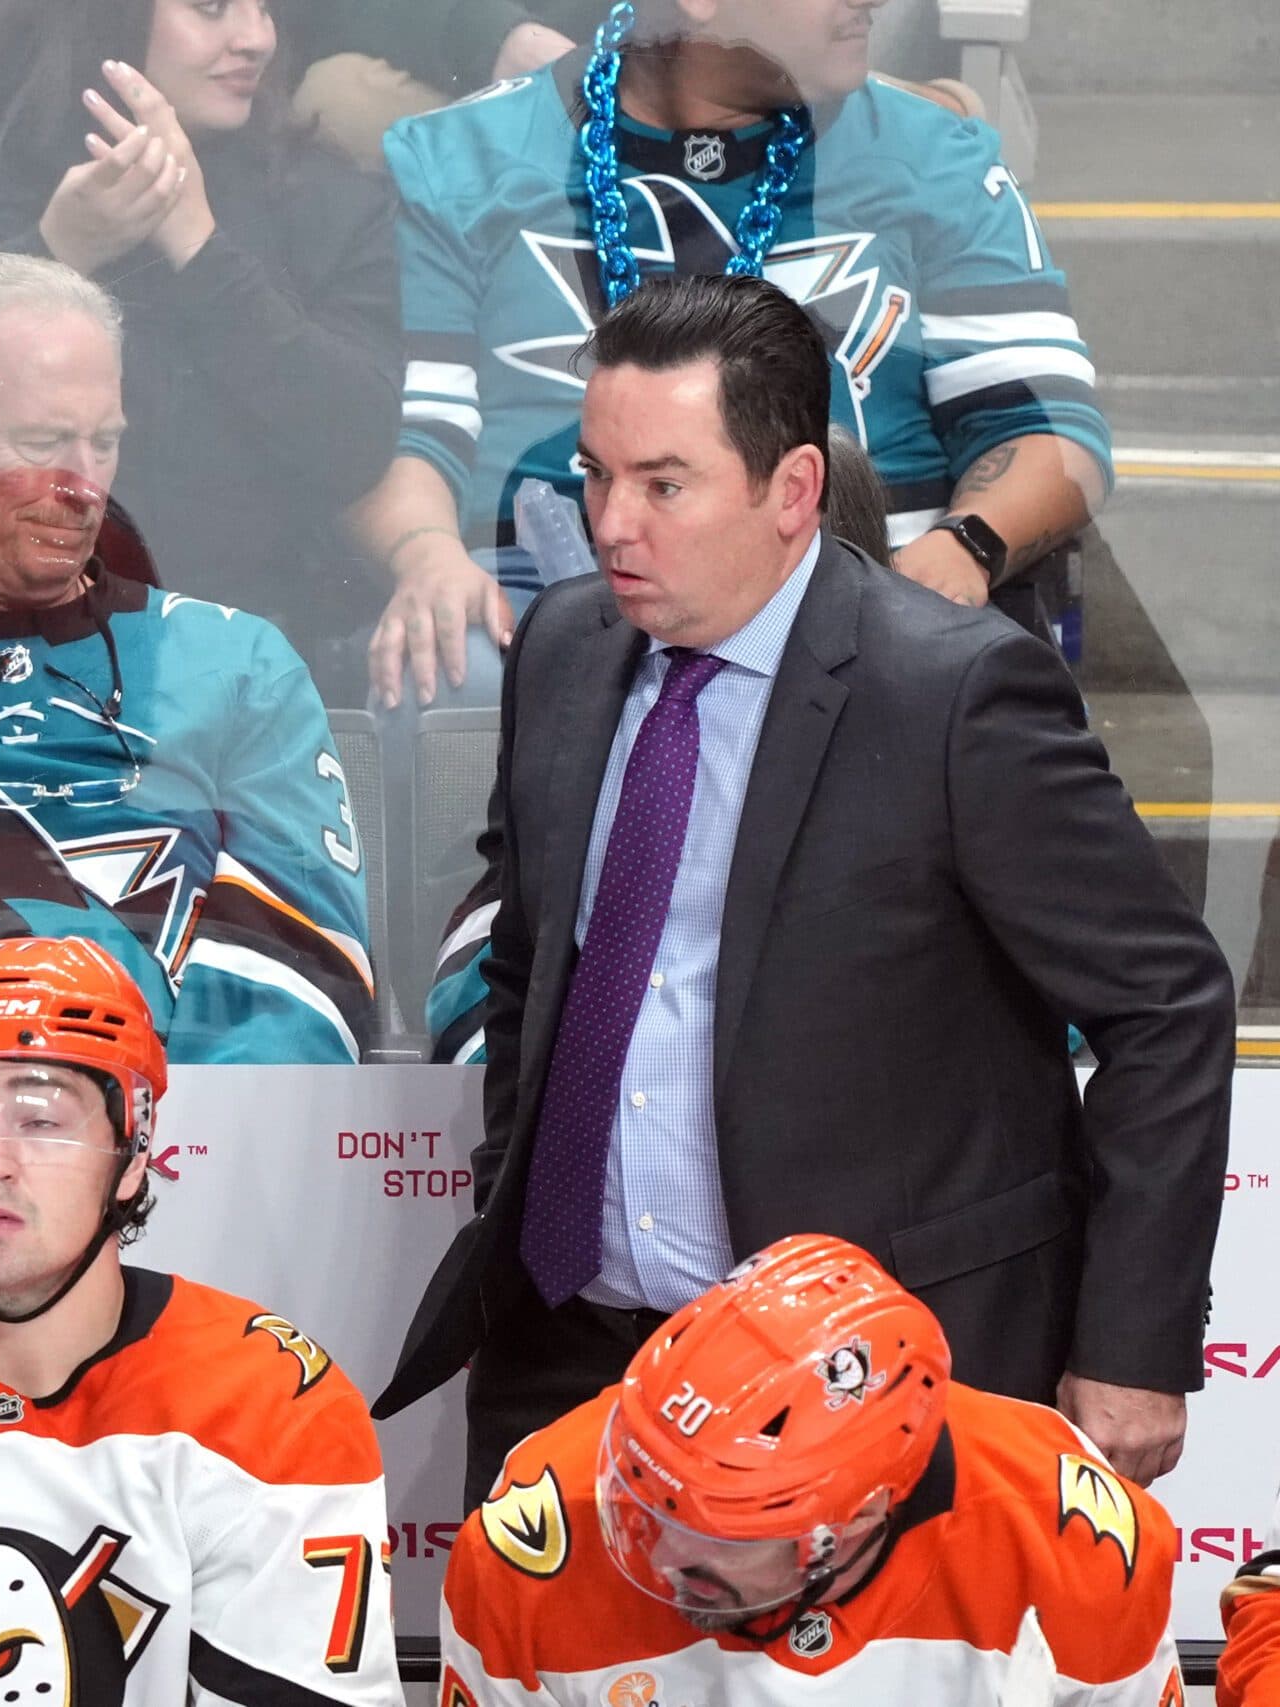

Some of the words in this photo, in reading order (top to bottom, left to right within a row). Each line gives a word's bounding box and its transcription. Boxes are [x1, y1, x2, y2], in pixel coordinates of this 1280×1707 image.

[691, 146, 718, 170] NHL
[316, 750, 361, 876] 3
[337, 1131, 442, 1159] DON'T
[383, 1169, 473, 1198] STOP
[660, 1380, 713, 1437] 20
[628, 1438, 684, 1492] BAUER
[799, 1623, 824, 1648] NHL
